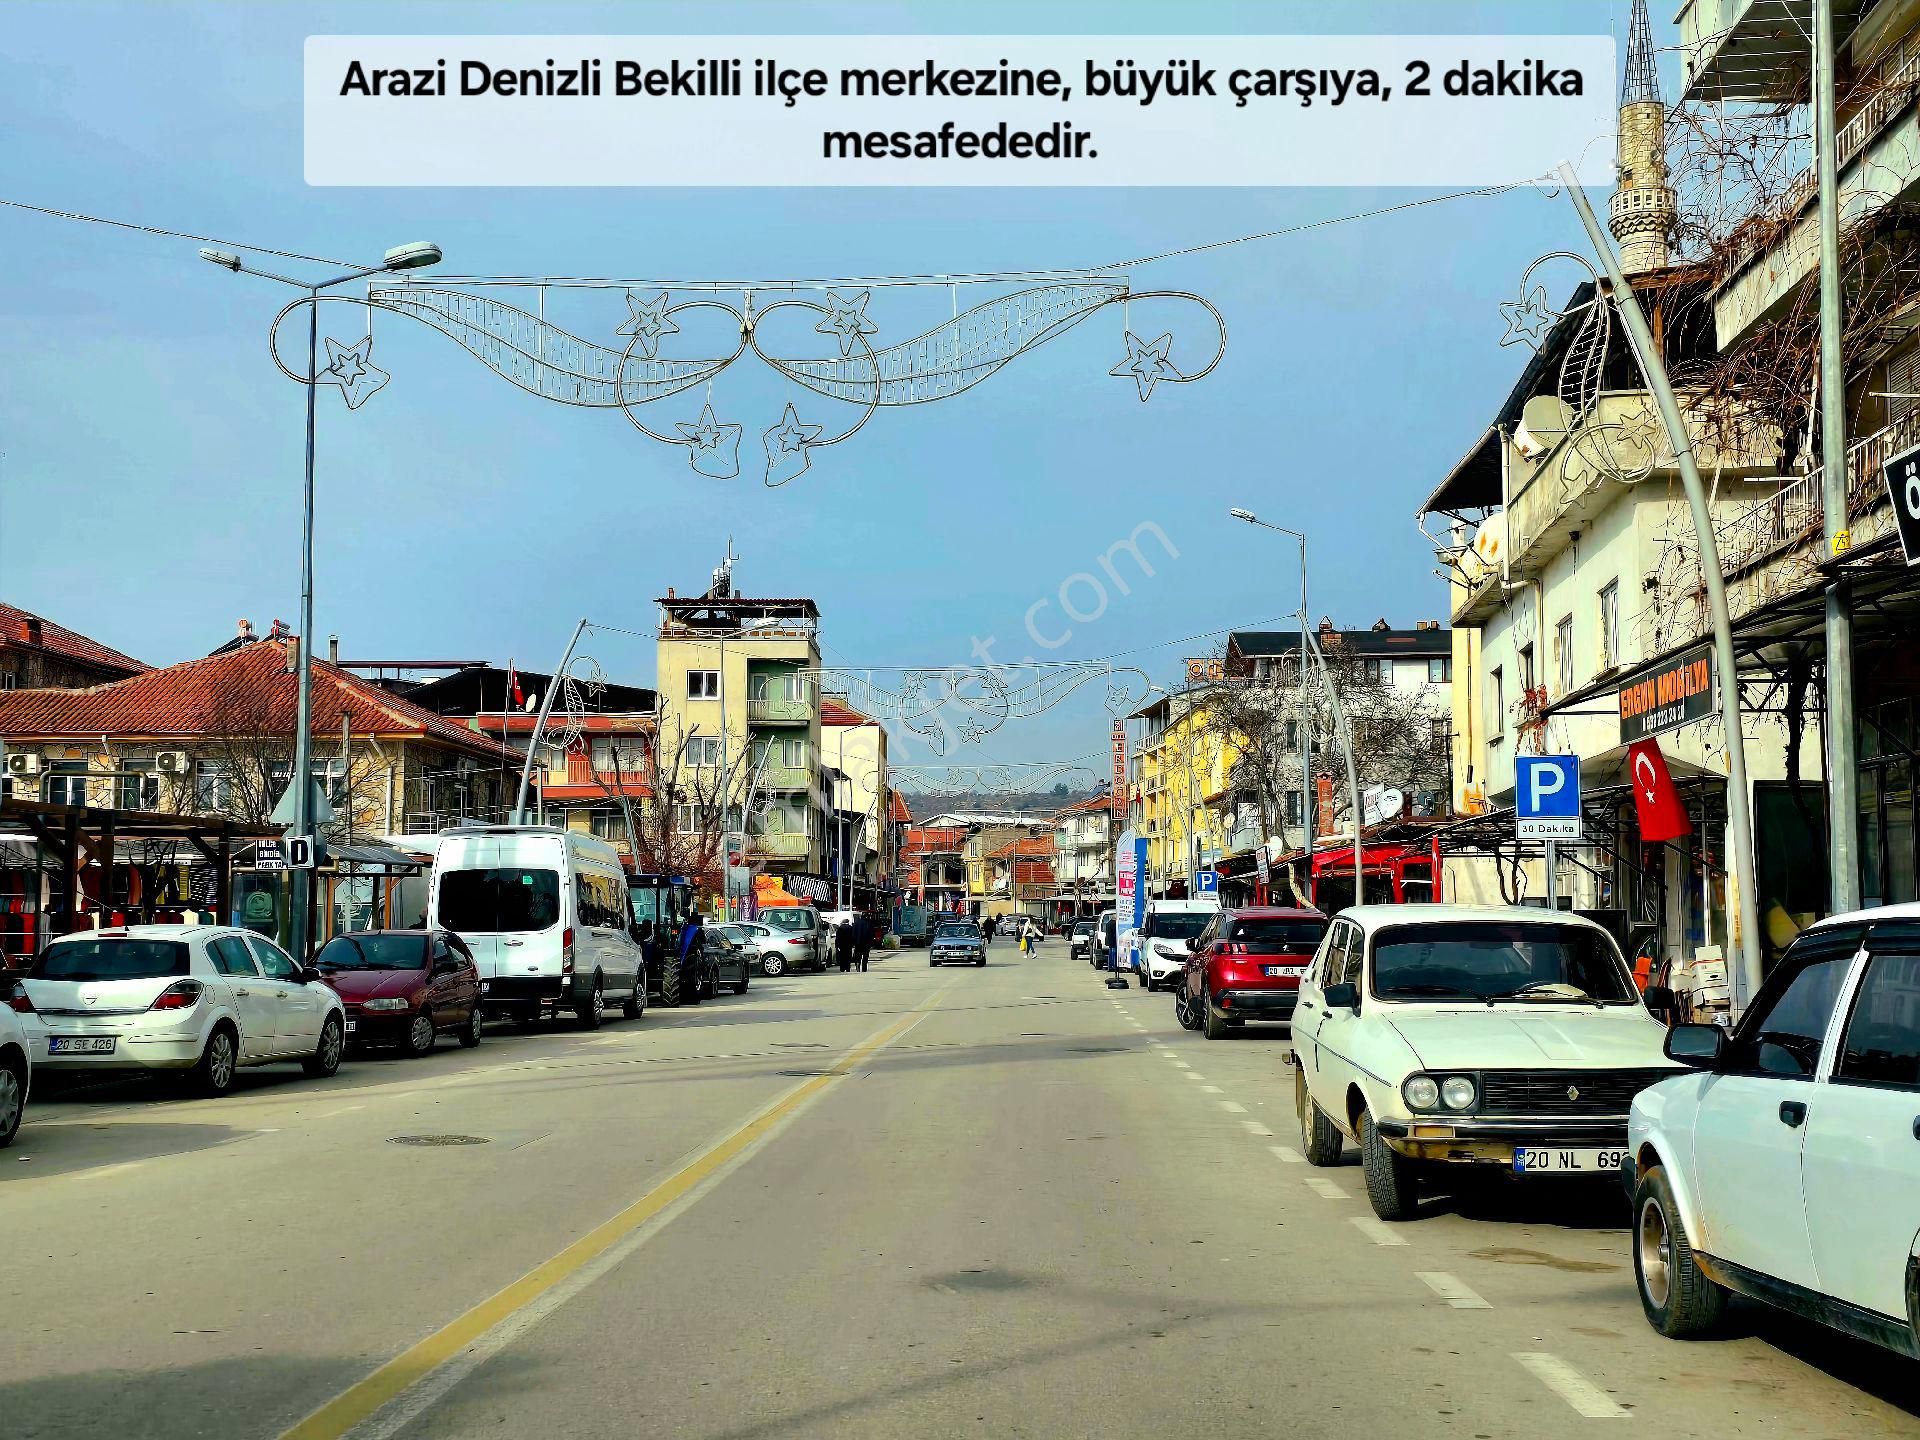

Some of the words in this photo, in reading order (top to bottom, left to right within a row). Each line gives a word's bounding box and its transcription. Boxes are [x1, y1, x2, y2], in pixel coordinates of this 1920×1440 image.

[1530, 762, 1565, 813] P
[1522, 824, 1534, 833] 30
[290, 839, 309, 866] D
[1201, 873, 1213, 890] P
[57, 1039, 70, 1050] 20
[92, 1039, 112, 1050] 426
[1525, 1151, 1549, 1169] 20
[1558, 1151, 1582, 1169] NL
[1597, 1151, 1629, 1169] 69
